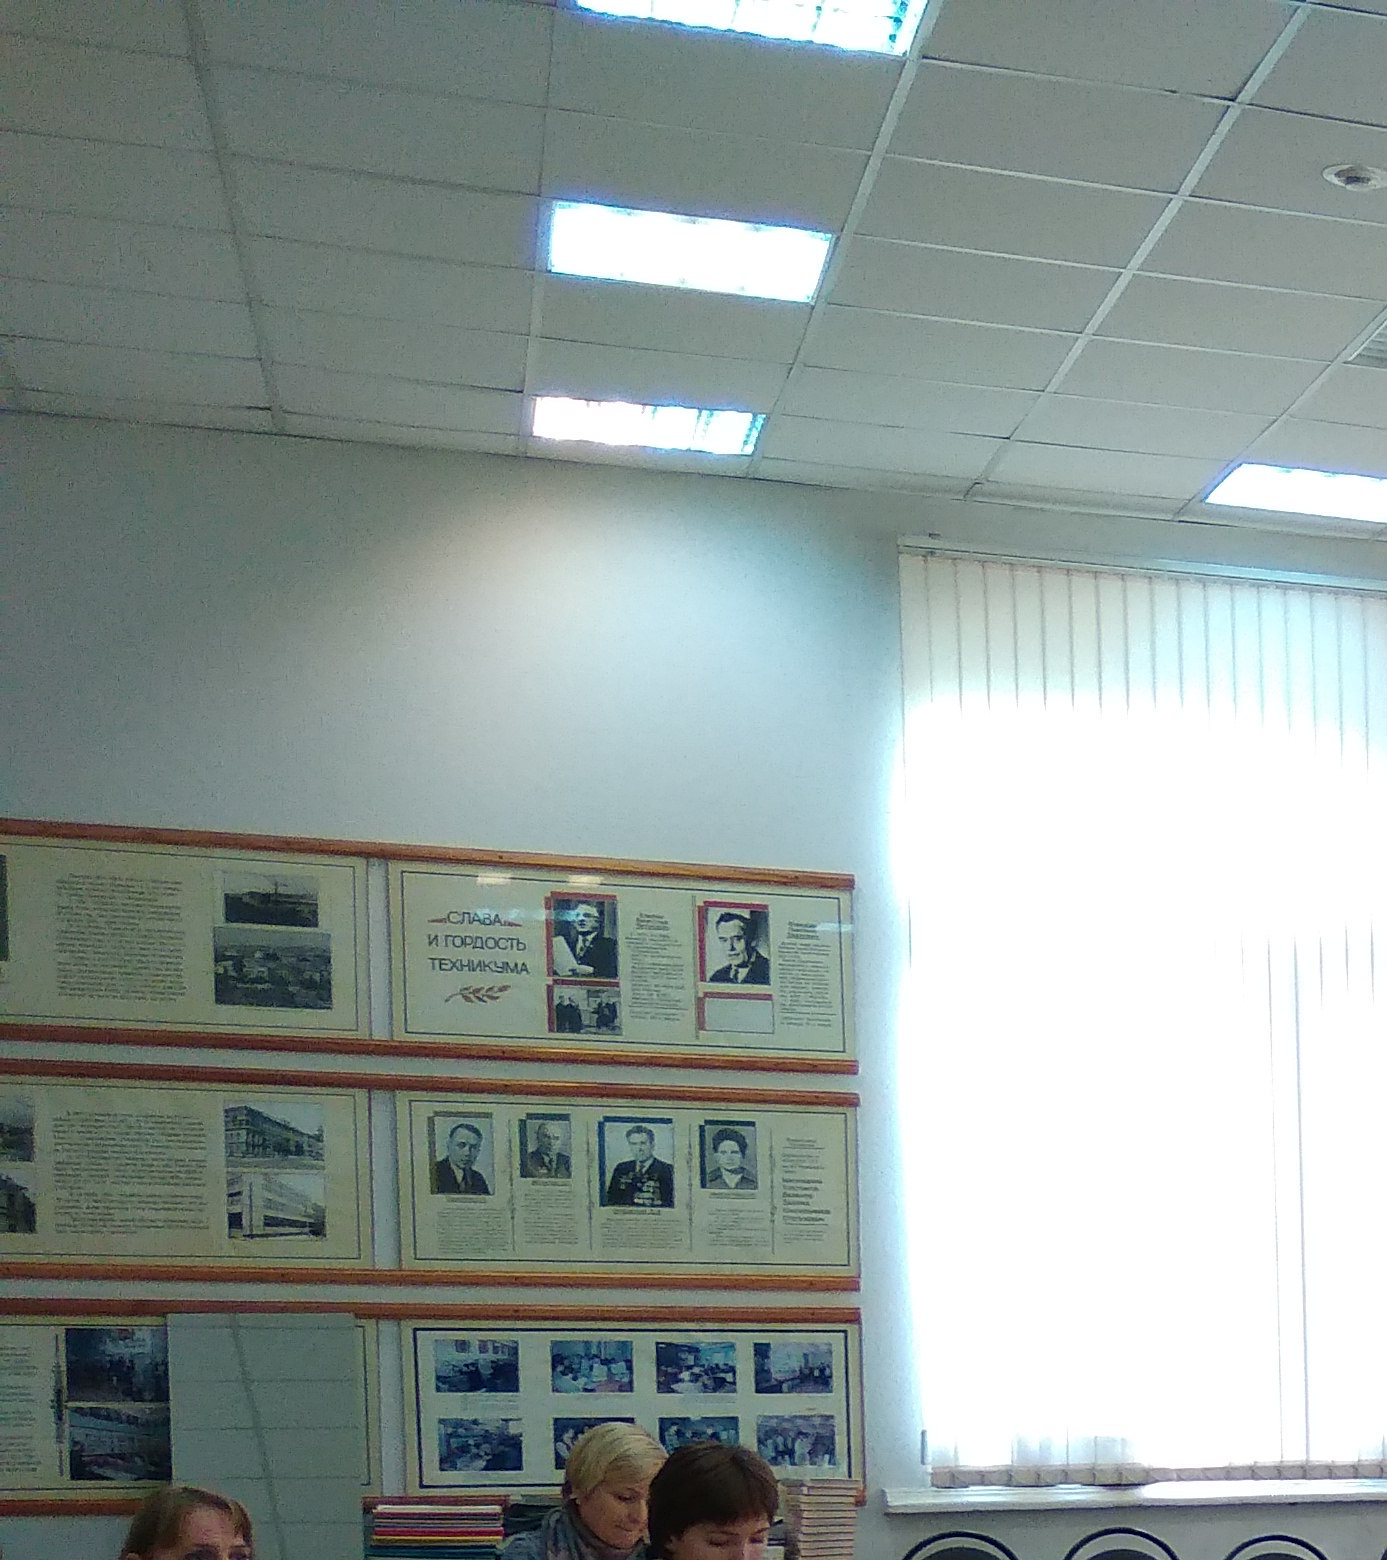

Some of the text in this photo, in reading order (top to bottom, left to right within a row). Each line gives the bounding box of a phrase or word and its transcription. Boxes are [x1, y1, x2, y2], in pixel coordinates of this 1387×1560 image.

[447, 910, 502, 926] СЛАВА
[427, 934, 527, 952] И ГОРДОСТЬ
[427, 957, 530, 975] ТЕХНИКУМА
